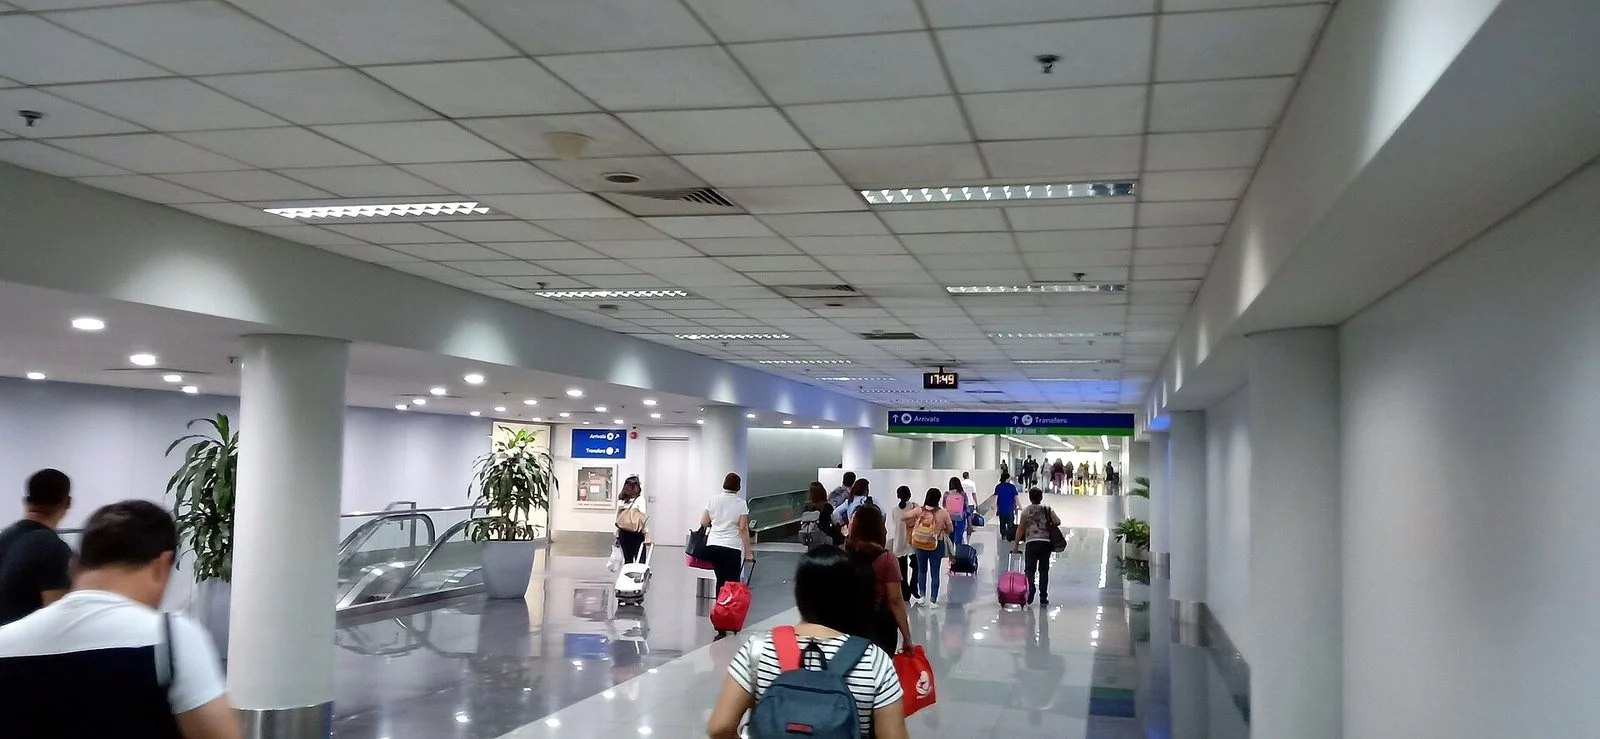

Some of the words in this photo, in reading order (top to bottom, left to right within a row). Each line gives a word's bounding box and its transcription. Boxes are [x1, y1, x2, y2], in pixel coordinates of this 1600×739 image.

[930, 374, 954, 385] 17:49
[913, 415, 940, 423] Arrivals
[1035, 416, 1068, 424] Transfers
